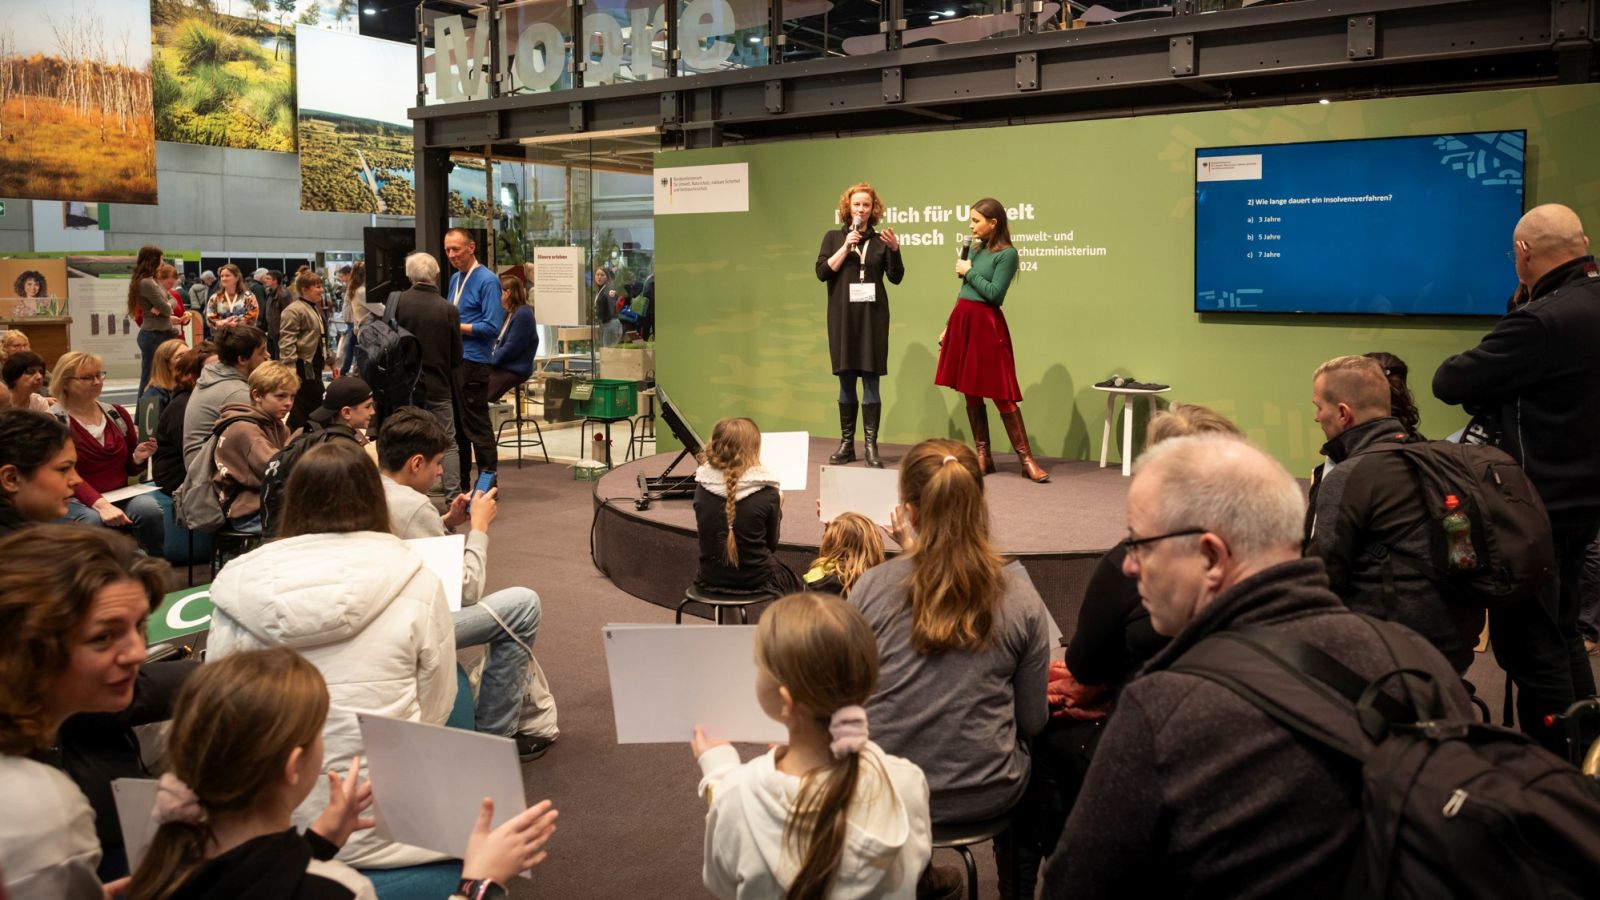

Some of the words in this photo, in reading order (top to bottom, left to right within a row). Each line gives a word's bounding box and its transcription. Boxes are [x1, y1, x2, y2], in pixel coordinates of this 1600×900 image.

[1270, 198, 1287, 207] lange
[1324, 194, 1392, 204] Insolvenzverfahren?
[924, 206, 952, 222] für
[956, 202, 1035, 222] Uelt
[1054, 230, 1074, 240] und
[1248, 233, 1254, 241] b)
[1019, 261, 1038, 272] 024
[146, 402, 154, 436] C
[166, 590, 212, 630] C
